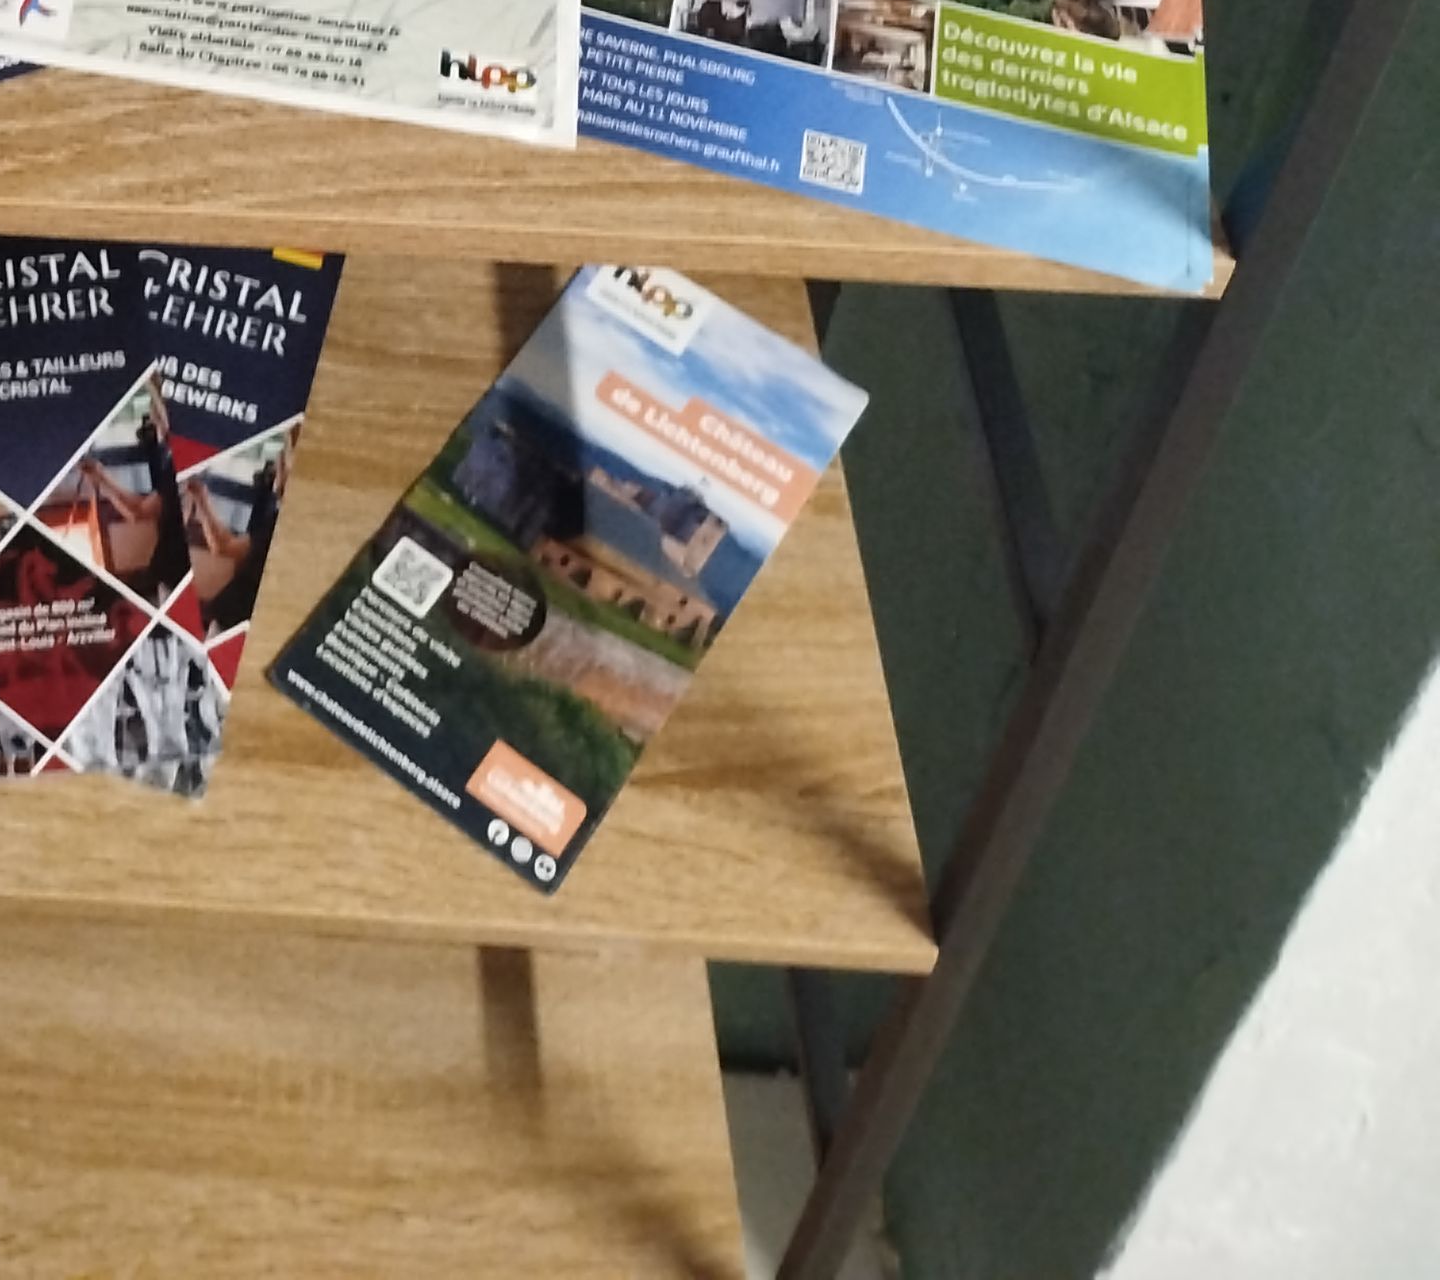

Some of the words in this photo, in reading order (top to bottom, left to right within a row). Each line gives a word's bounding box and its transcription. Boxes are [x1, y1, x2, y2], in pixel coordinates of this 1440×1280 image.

[586, 45, 634, 72] PETITE
[635, 59, 686, 86] PIERRE
[663, 48, 756, 87] PHALSBOURG
[941, 44, 985, 72] des
[989, 55, 1090, 97] derniers
[943, 20, 1068, 69] Découvrez
[1073, 51, 1096, 76] la
[1101, 61, 1139, 85] vie
[581, 85, 622, 110] MARS
[624, 98, 646, 116] AU
[668, 109, 749, 144] NOVEMBRE
[601, 71, 637, 96] TOUS
[638, 82, 665, 102] LES
[665, 91, 710, 115] JOURS
[941, 67, 1081, 119] troglodytes
[1086, 102, 1189, 143] d'Alsace
[16, 360, 30, 378] &
[31, 349, 127, 376] TAILLEURS
[181, 361, 223, 391] DES
